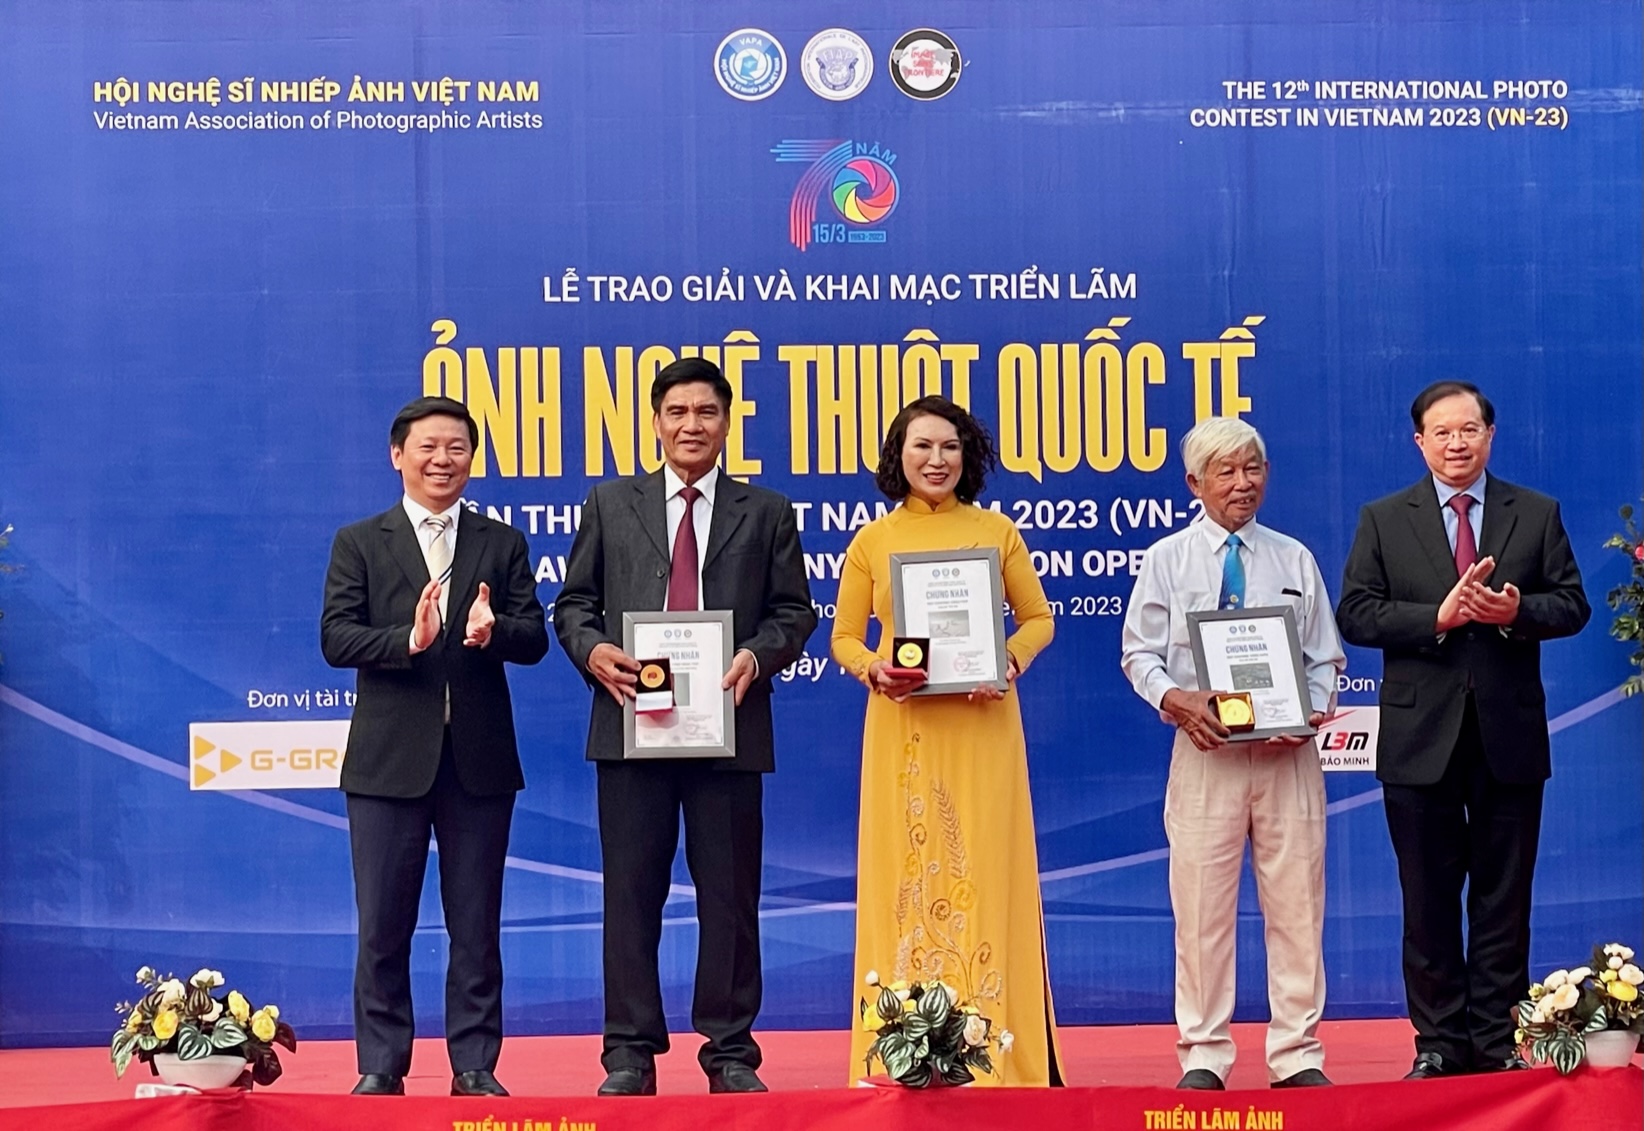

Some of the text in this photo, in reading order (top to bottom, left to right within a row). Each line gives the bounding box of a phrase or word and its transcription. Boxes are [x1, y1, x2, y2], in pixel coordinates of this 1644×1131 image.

[739, 37, 763, 46] VAPA
[822, 48, 854, 61] FIAP
[94, 75, 539, 107] HỘI NGHỆ SĨ NHIẾP ẢNH VIỆT NAM
[1223, 80, 1568, 99] THE 12th INTERNATIONAL PHOTO
[94, 110, 543, 133] Vietnam Association of Photographic Artists
[1191, 107, 1568, 130] CONTEST IN VIETNAM 2023 (VN-23)
[856, 142, 898, 165] NĂM
[813, 223, 845, 243] 15/3
[543, 265, 1137, 305] LỄ TRAO GIẢI VÀ KHAI MẠC TRIỂN LÃM
[998, 317, 1167, 484] QUỐC
[1012, 500, 1099, 529] 2023
[1110, 497, 1206, 536] (VN-2
[1070, 596, 1122, 616] 2023
[1336, 675, 1376, 692] Đơn
[247, 690, 289, 708] Đơn
[294, 689, 310, 711] vị
[315, 689, 339, 707] tài
[250, 748, 344, 771] G-GR
[1343, 757, 1370, 766] MINH
[1144, 1103, 1283, 1130] TRIỂN LÃM ẢNH
